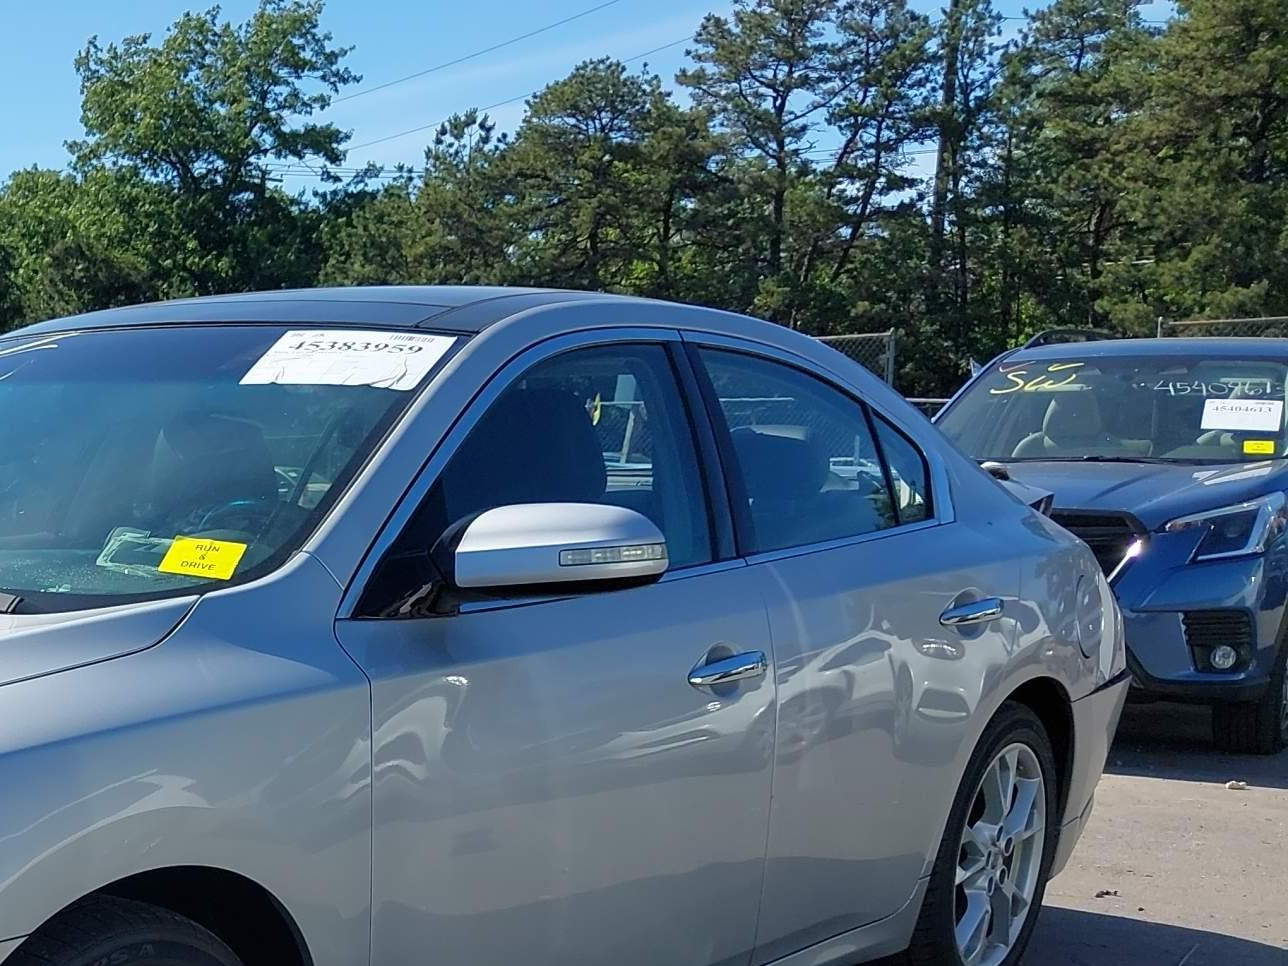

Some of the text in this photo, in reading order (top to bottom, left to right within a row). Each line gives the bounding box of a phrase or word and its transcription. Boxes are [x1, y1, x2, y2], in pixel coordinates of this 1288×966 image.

[288, 340, 424, 355] 45383959
[195, 544, 221, 552] RUN
[180, 560, 217, 571] DRIVE
